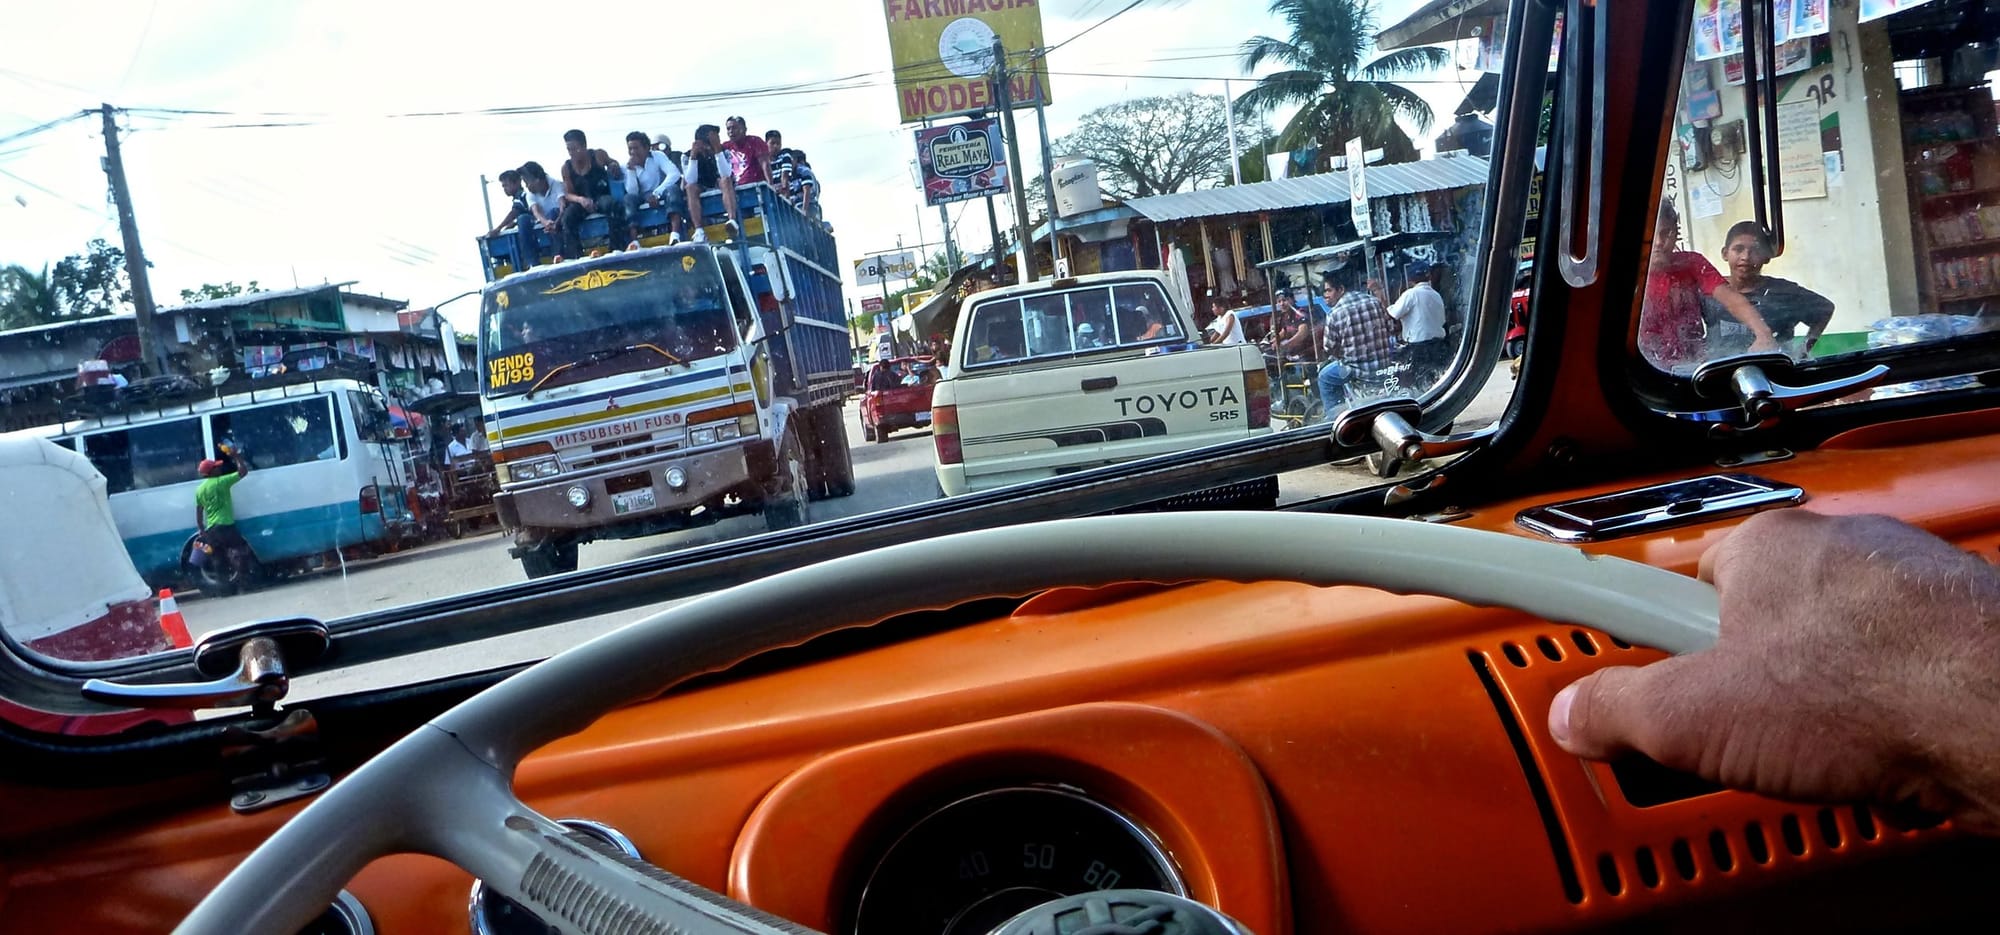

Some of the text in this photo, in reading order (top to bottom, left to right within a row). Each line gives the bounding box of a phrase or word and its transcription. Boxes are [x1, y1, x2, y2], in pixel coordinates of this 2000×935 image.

[888, 0, 1035, 22] FARMA
[488, 352, 535, 374] VENDO
[490, 366, 535, 389] M/99
[1114, 385, 1239, 416] TOYOTA
[1209, 409, 1240, 422] SR5
[554, 413, 682, 447] MITSUBISHI FUSO
[1023, 843, 1056, 869] 50
[1083, 859, 1121, 890] 60
